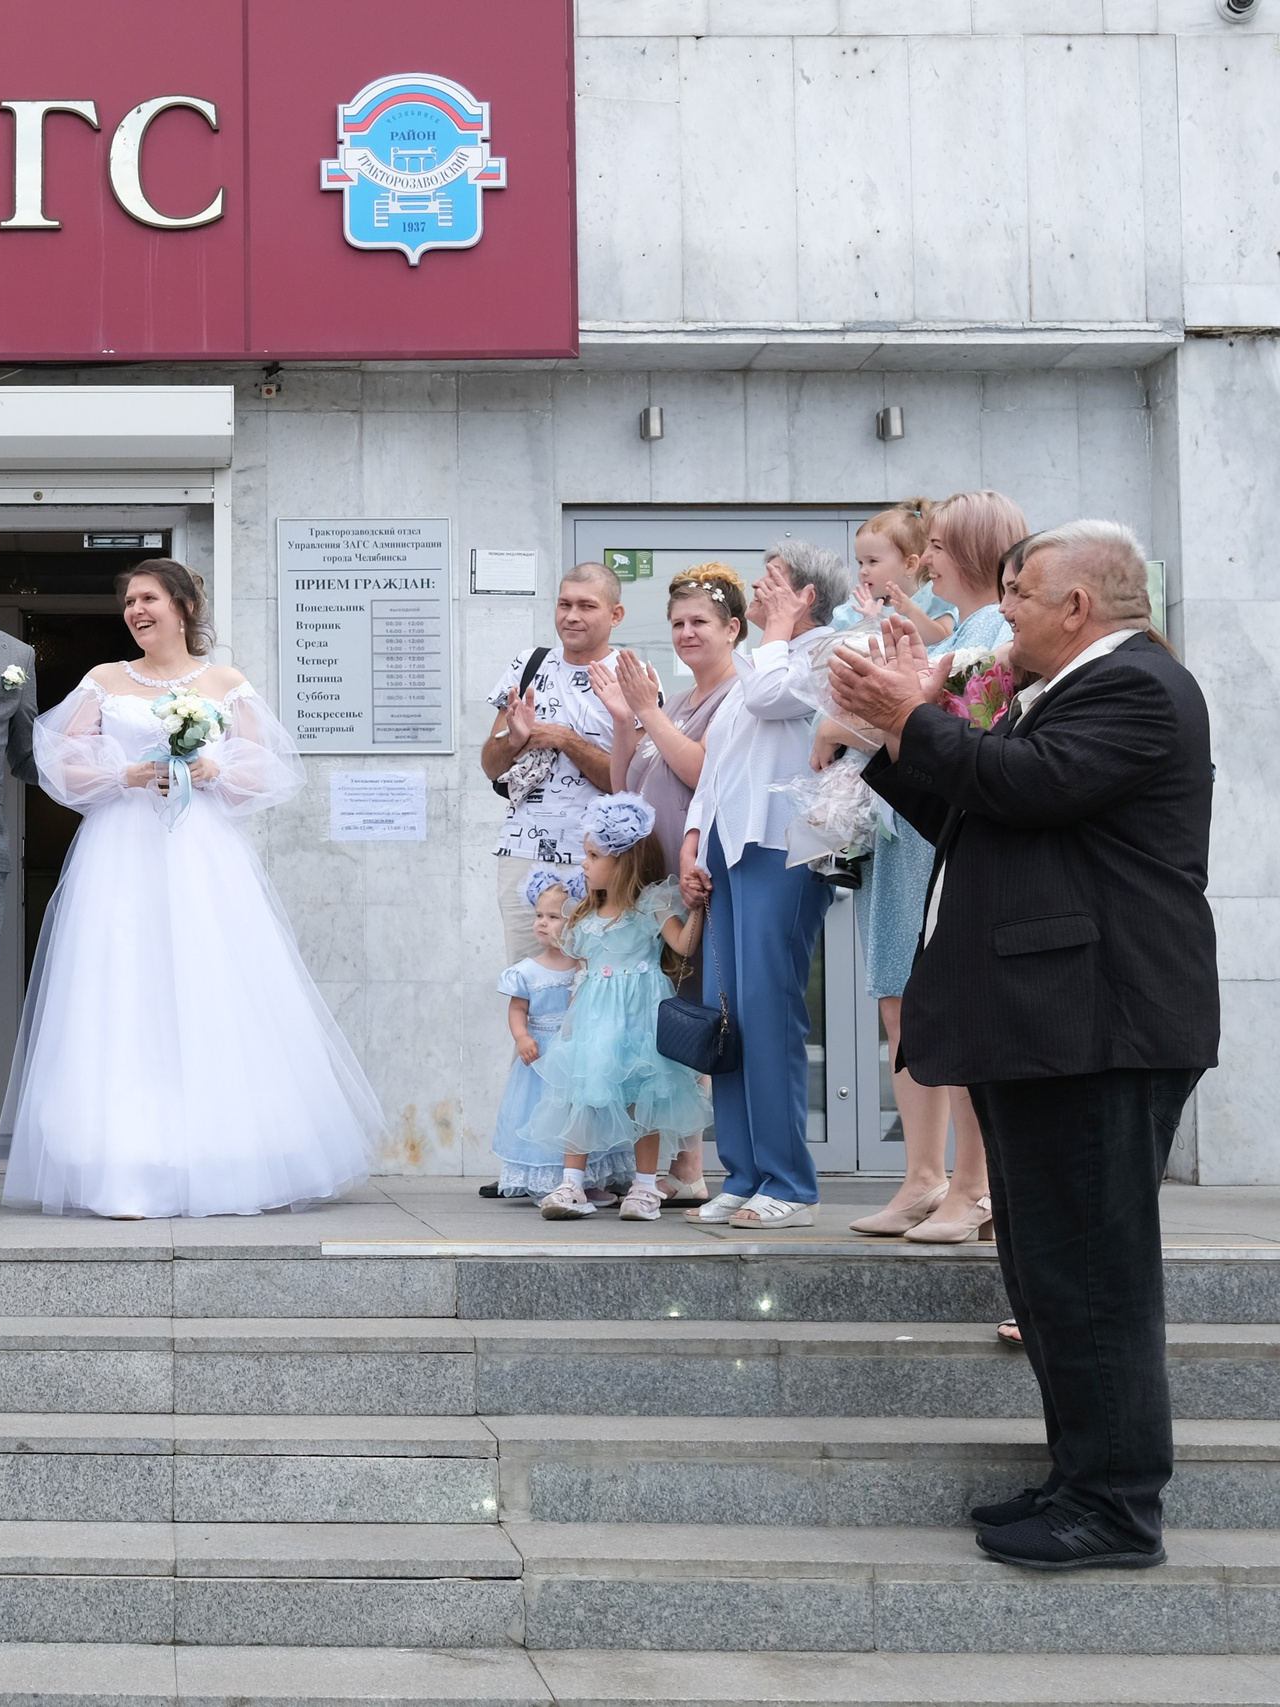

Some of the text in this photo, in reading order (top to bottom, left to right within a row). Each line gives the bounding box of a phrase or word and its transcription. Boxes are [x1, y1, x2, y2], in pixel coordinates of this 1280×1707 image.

[386, 110, 440, 124] ЧЕЛЯБИНСК
[390, 129, 436, 141] РАЙОН
[357, 151, 470, 189] ТРАКТОРОЗАВОДСКИЙ
[402, 221, 426, 233] 1937
[308, 527, 421, 538] Тракторозаводский отдел
[287, 540, 442, 550] Управления ЗАГС Администрации
[322, 553, 407, 564] города Челябинска
[295, 578, 436, 591] ПРИЕМ ГРАЖДАН:
[296, 603, 365, 613] Понедельник
[296, 621, 341, 632] Вторник
[296, 638, 328, 649] Среда
[297, 656, 339, 667] Четверг
[297, 674, 343, 684] Пятница
[297, 691, 341, 703] Суббота
[297, 710, 363, 720] Воскресенье
[297, 724, 355, 734] Санитарный
[297, 732, 317, 740] день
